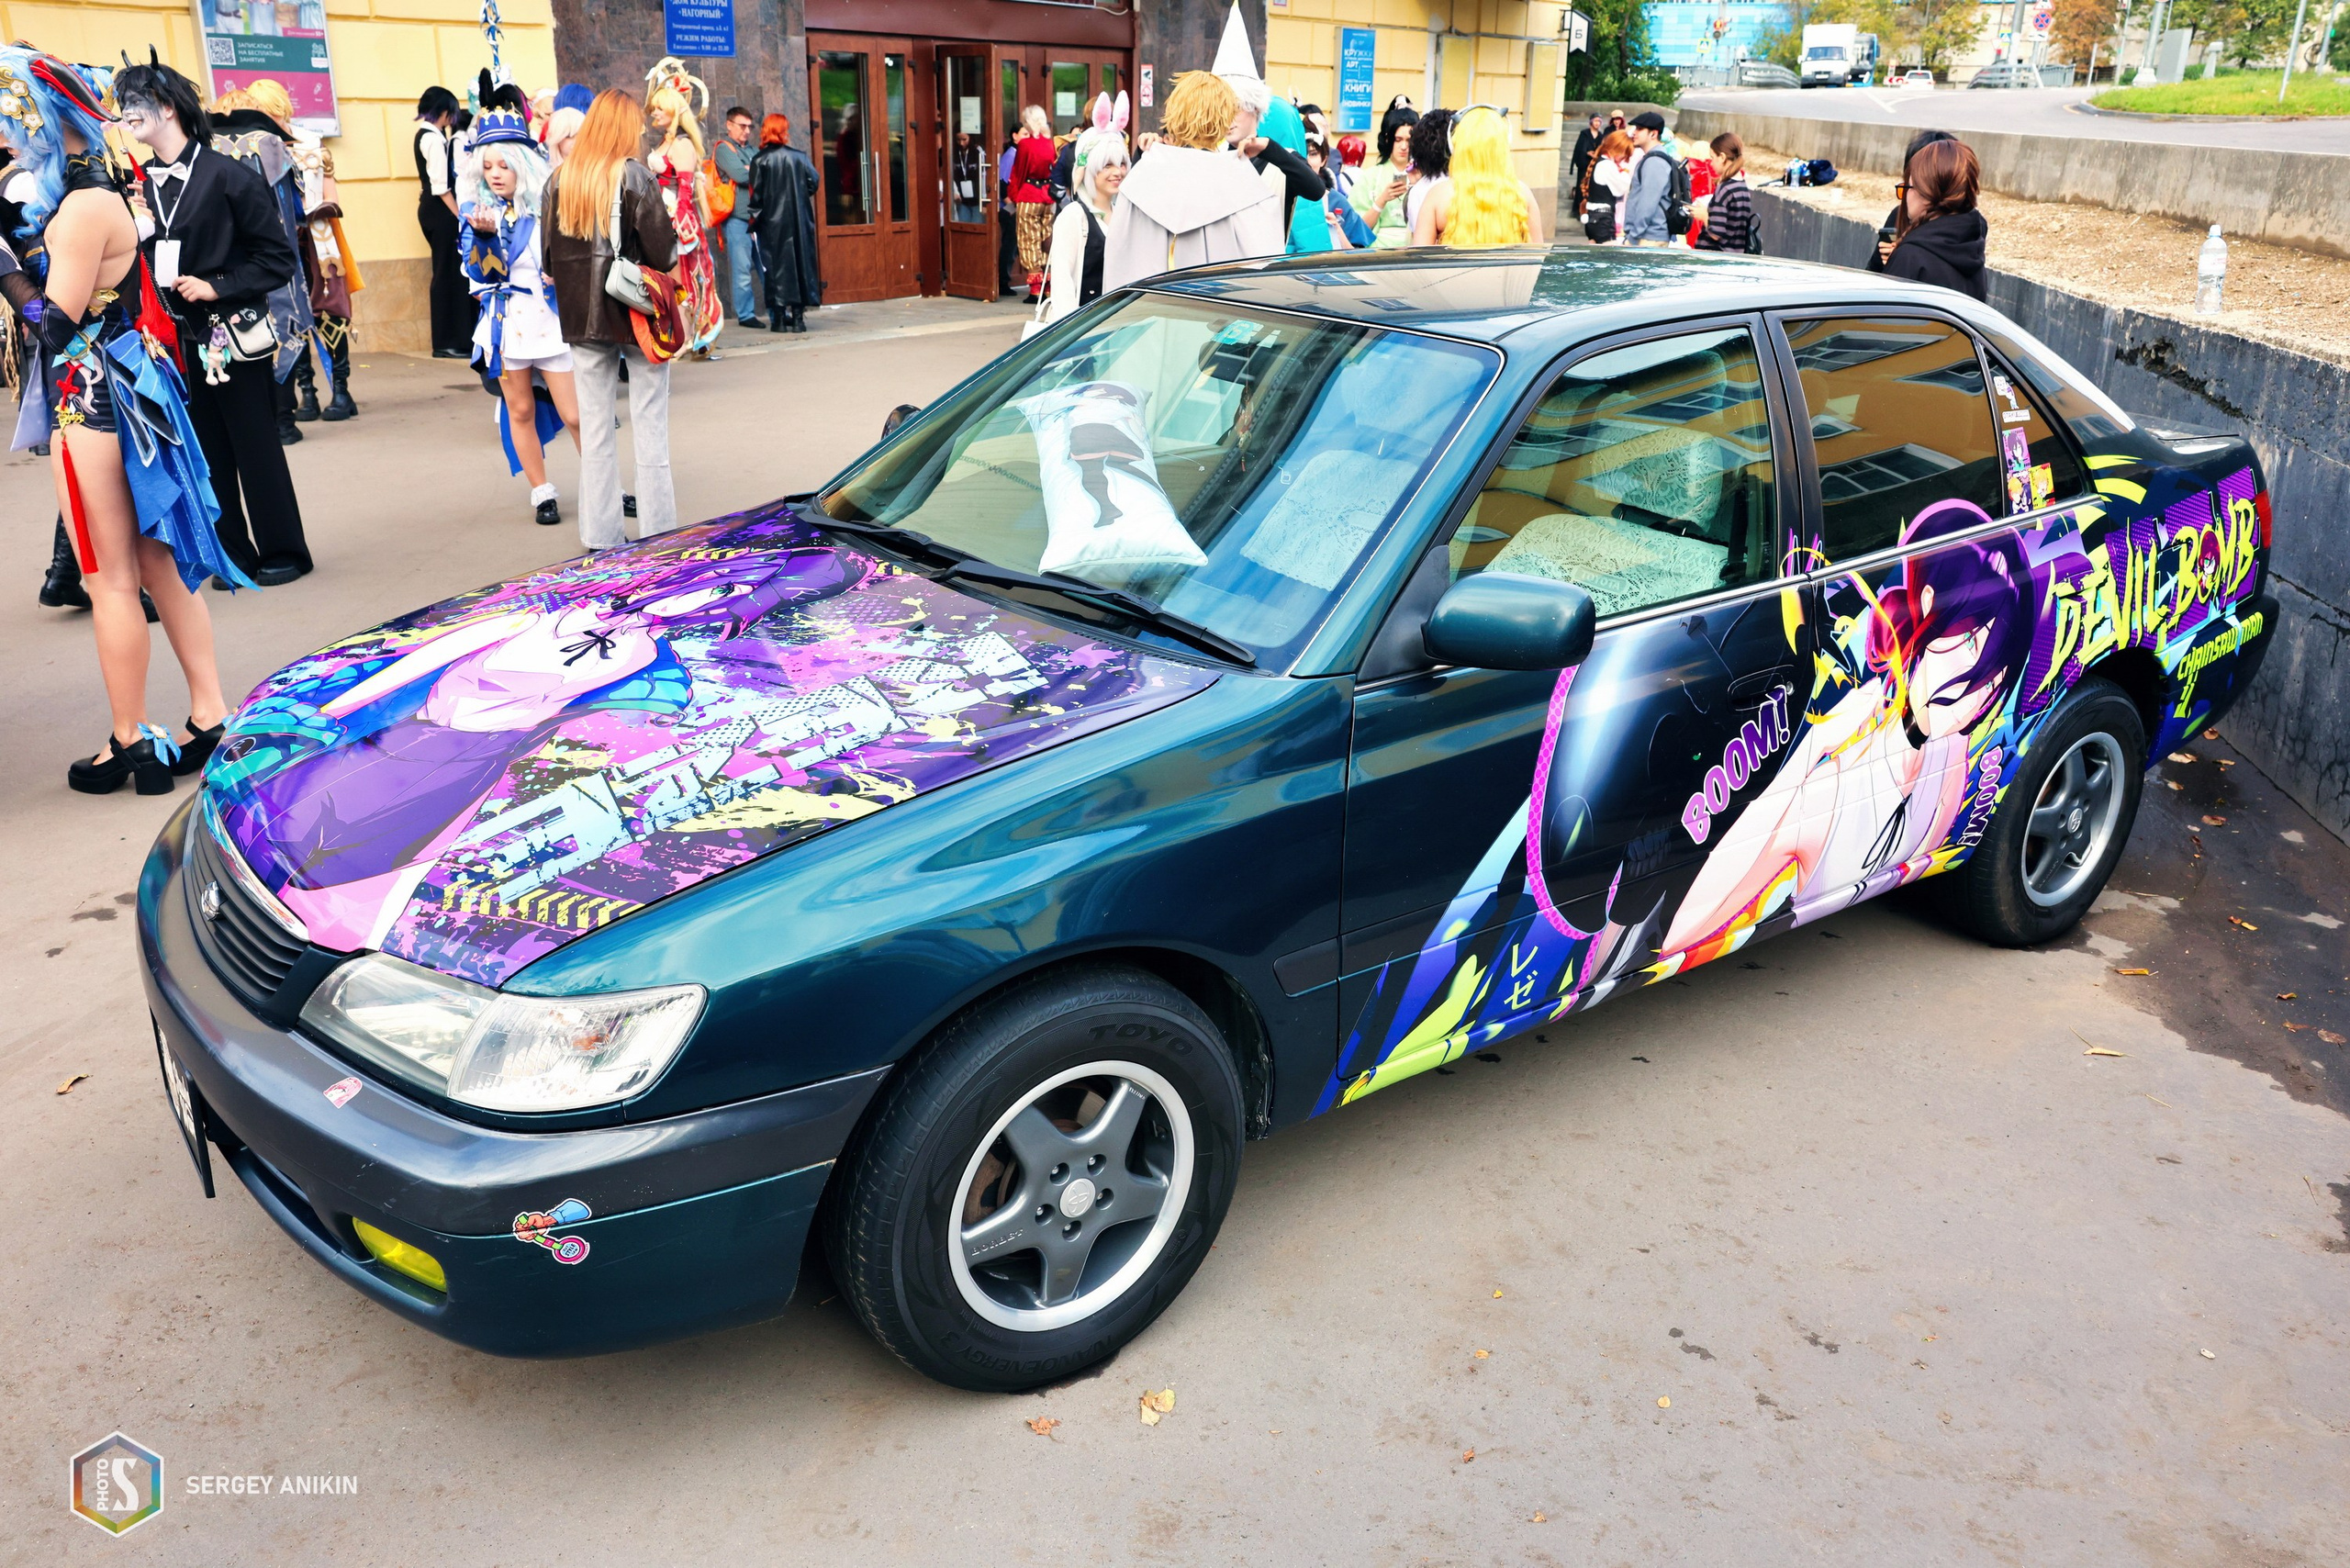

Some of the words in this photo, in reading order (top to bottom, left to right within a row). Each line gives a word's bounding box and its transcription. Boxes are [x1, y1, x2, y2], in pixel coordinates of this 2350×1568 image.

[237, 41, 274, 50] ЗАПИСАТЬСЯ
[248, 50, 285, 58] БЕСПЛАТНЫЕ
[1346, 61, 1359, 69] АРТ
[1345, 84, 1371, 93] КНИГИ
[2029, 517, 2171, 702] DEVIL
[2172, 492, 2255, 622] BOMB
[2177, 626, 2239, 681] CHAINSAW
[2240, 610, 2264, 646] MAN
[1681, 684, 1789, 846] BOOM!
[1956, 745, 2004, 847] BOOM!
[1504, 941, 1539, 1012] レゼ
[1087, 1023, 1193, 1056] TOYO
